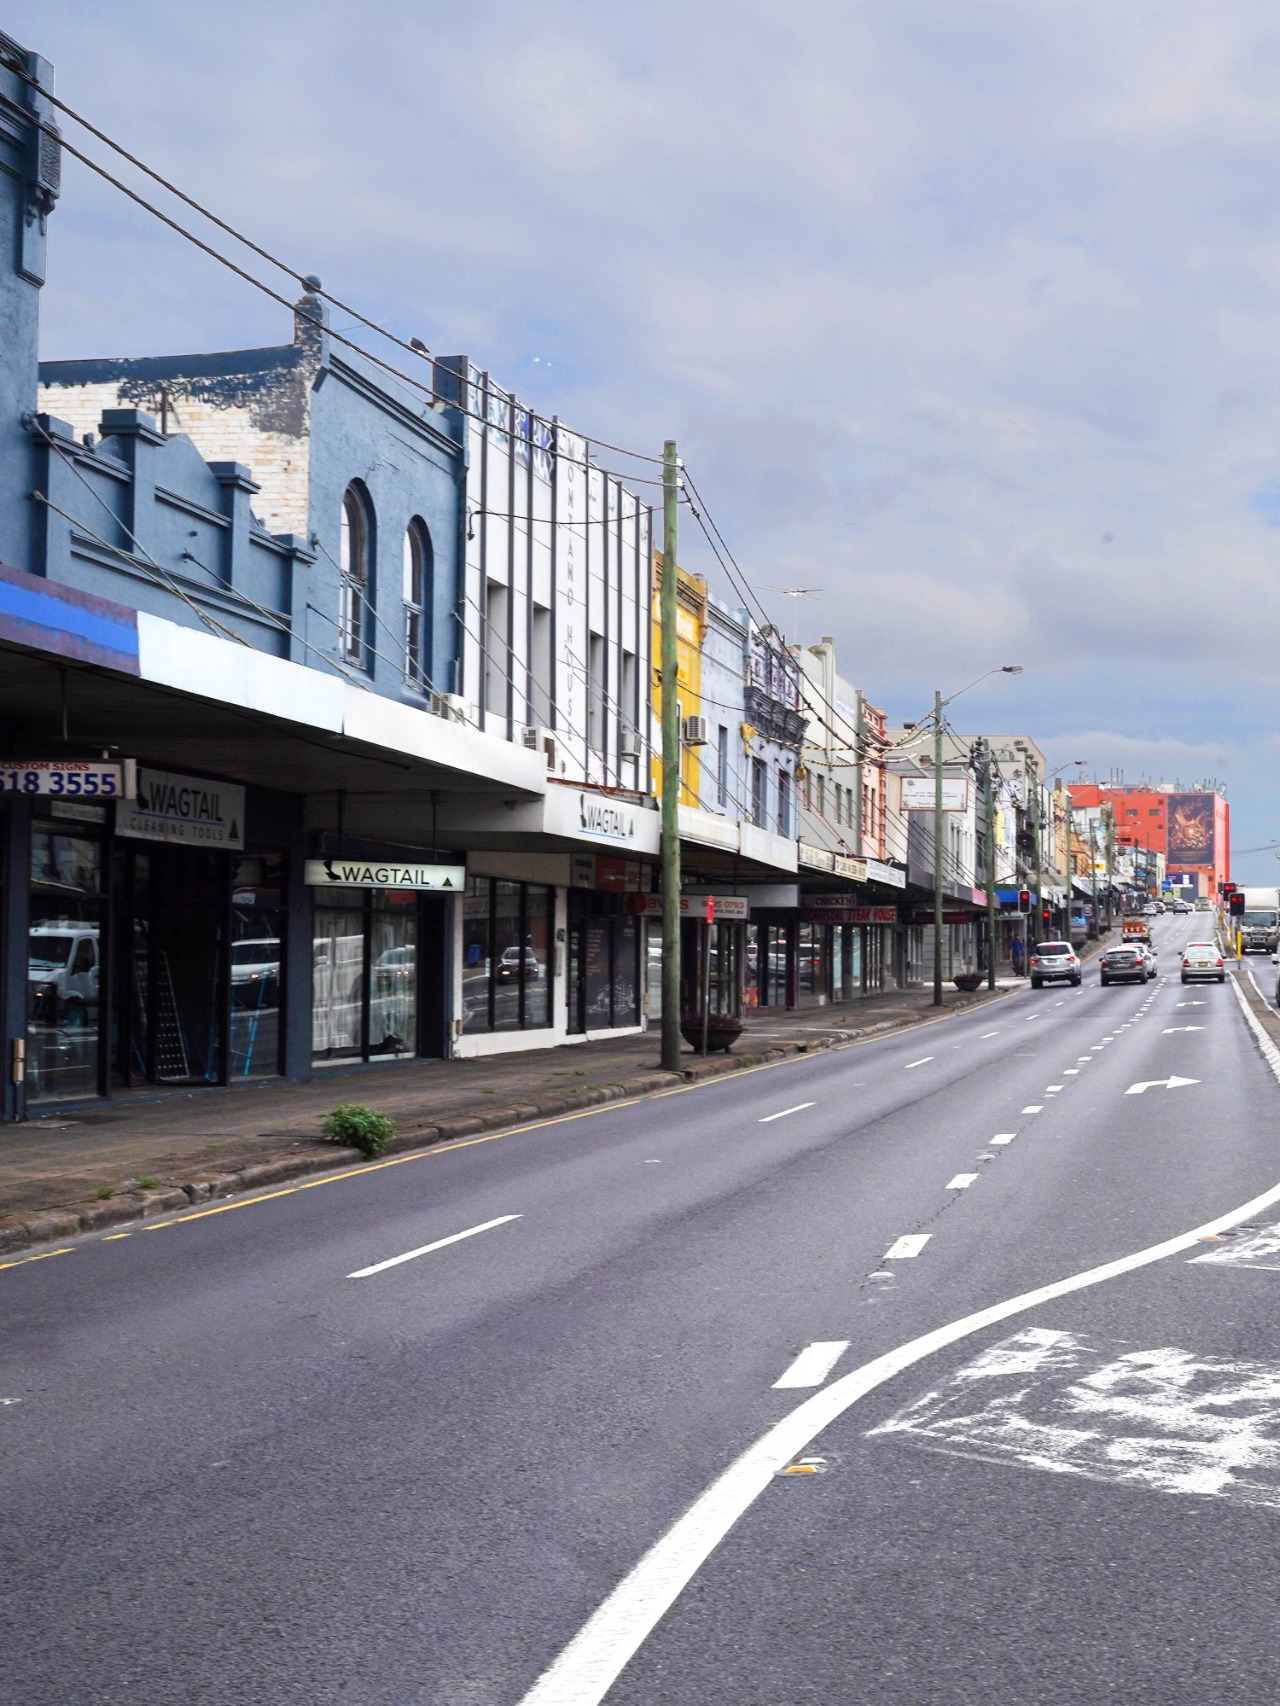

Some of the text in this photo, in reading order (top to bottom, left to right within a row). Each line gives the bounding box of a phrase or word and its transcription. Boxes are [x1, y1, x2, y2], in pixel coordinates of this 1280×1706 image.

[565, 437, 576, 741] MONTANO HOUSE
[0, 762, 90, 772] CUSTOM SIGNS
[48, 772, 116, 796] 3555
[149, 782, 224, 822] WAGTAIL
[130, 817, 224, 841] CLEANING TOOLS
[587, 804, 626, 837] WAGTAIL
[342, 866, 430, 885] WAGTAIL
[815, 896, 852, 906] CHICKEN
[847, 908, 872, 921] STEAK
[873, 907, 896, 921] HOUSE
